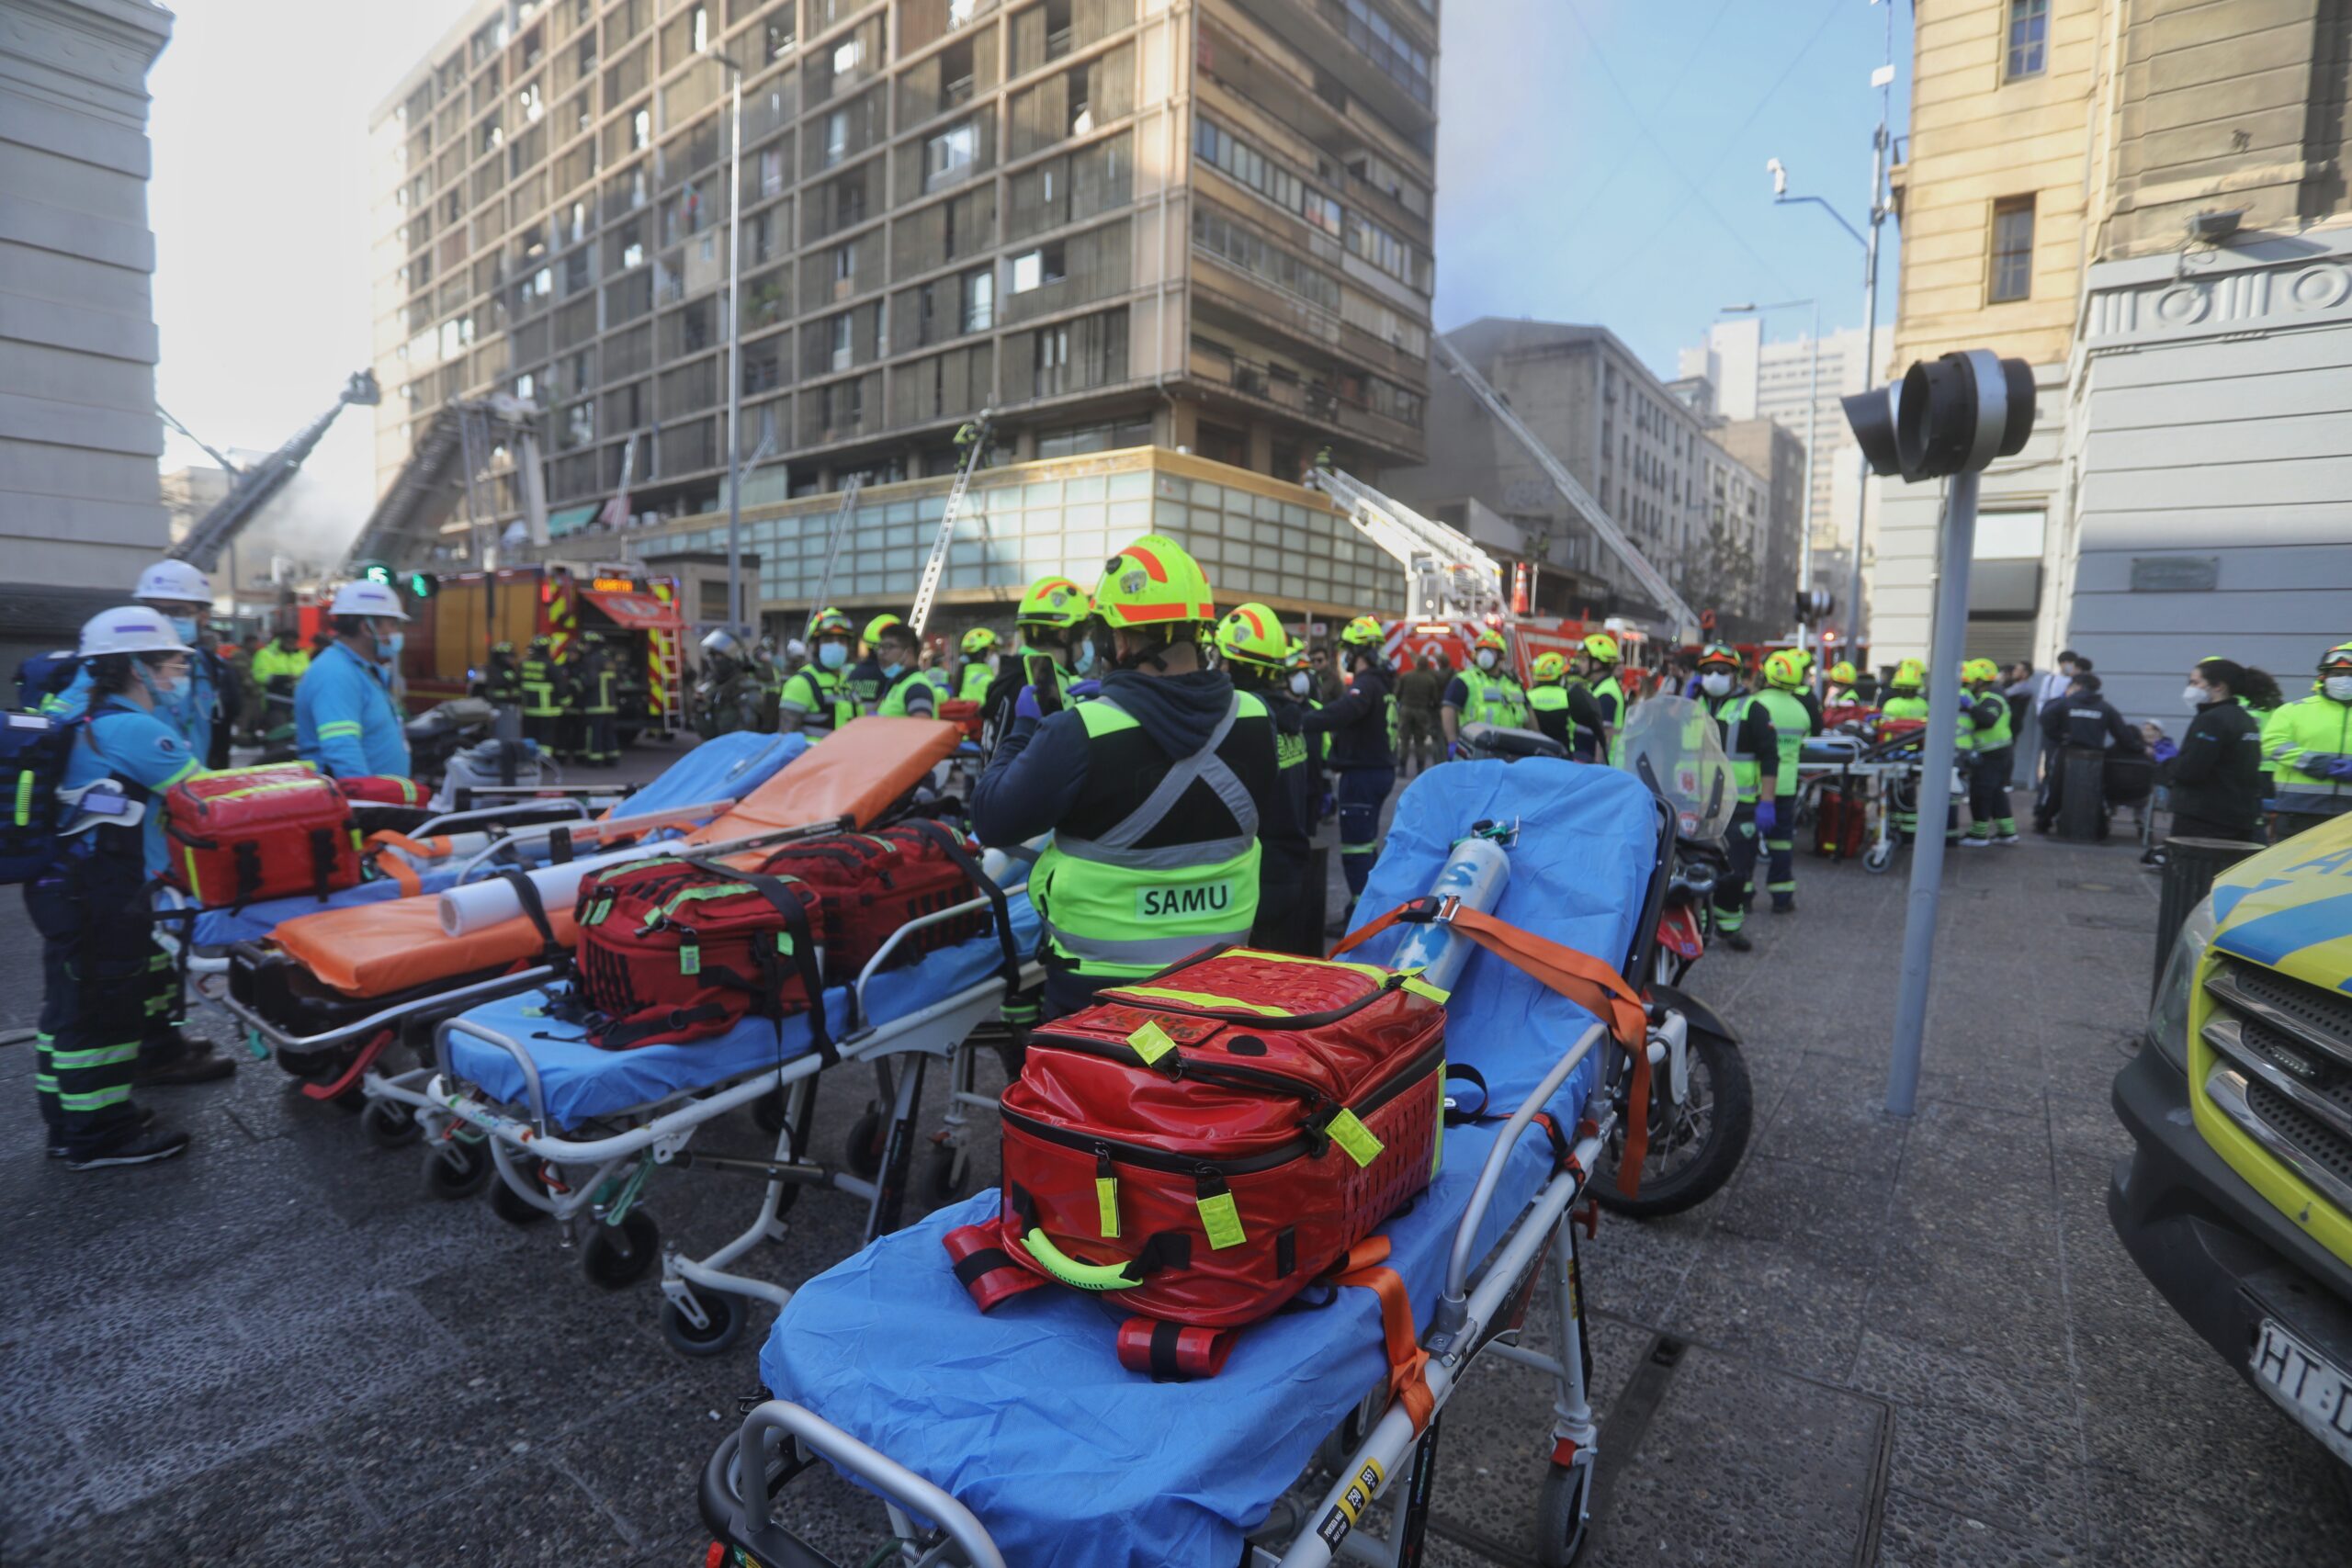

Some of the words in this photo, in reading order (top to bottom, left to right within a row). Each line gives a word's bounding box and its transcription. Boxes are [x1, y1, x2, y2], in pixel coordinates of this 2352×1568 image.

[1144, 885, 1227, 916] SAMU
[1362, 1467, 1375, 1485] 551
[1348, 1488, 1362, 1506] 250
[1334, 1510, 1344, 1523] MAX
